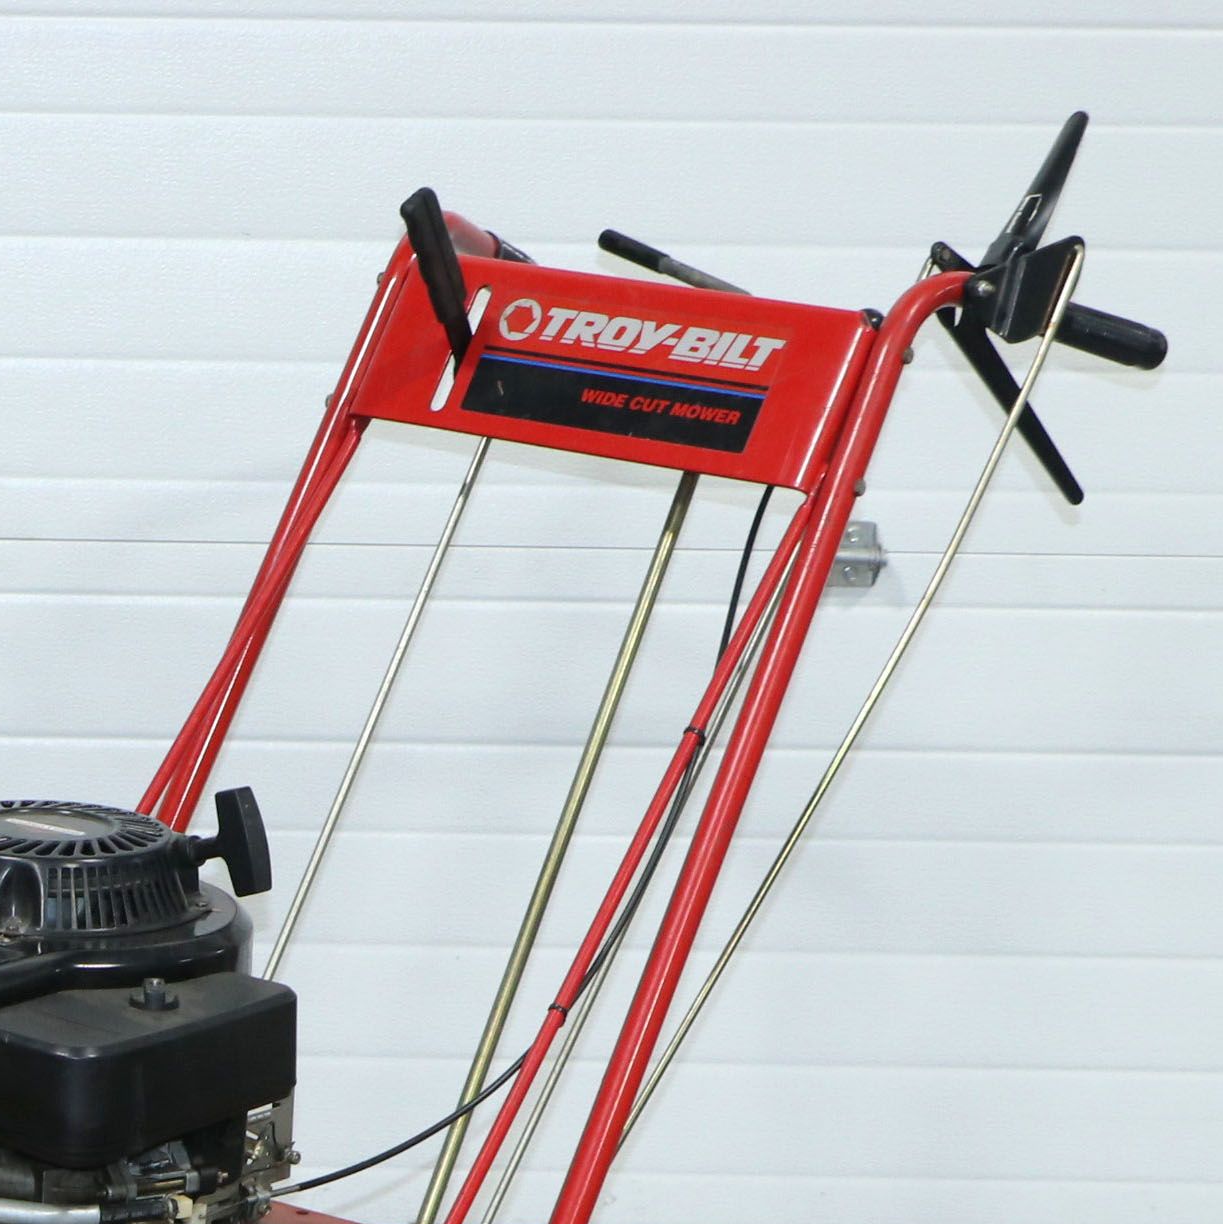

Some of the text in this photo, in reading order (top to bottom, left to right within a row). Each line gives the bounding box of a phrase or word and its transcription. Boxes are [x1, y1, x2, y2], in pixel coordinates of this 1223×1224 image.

[539, 307, 786, 371] TROY-BILT
[581, 388, 742, 425] WIDE CUT MOWER
